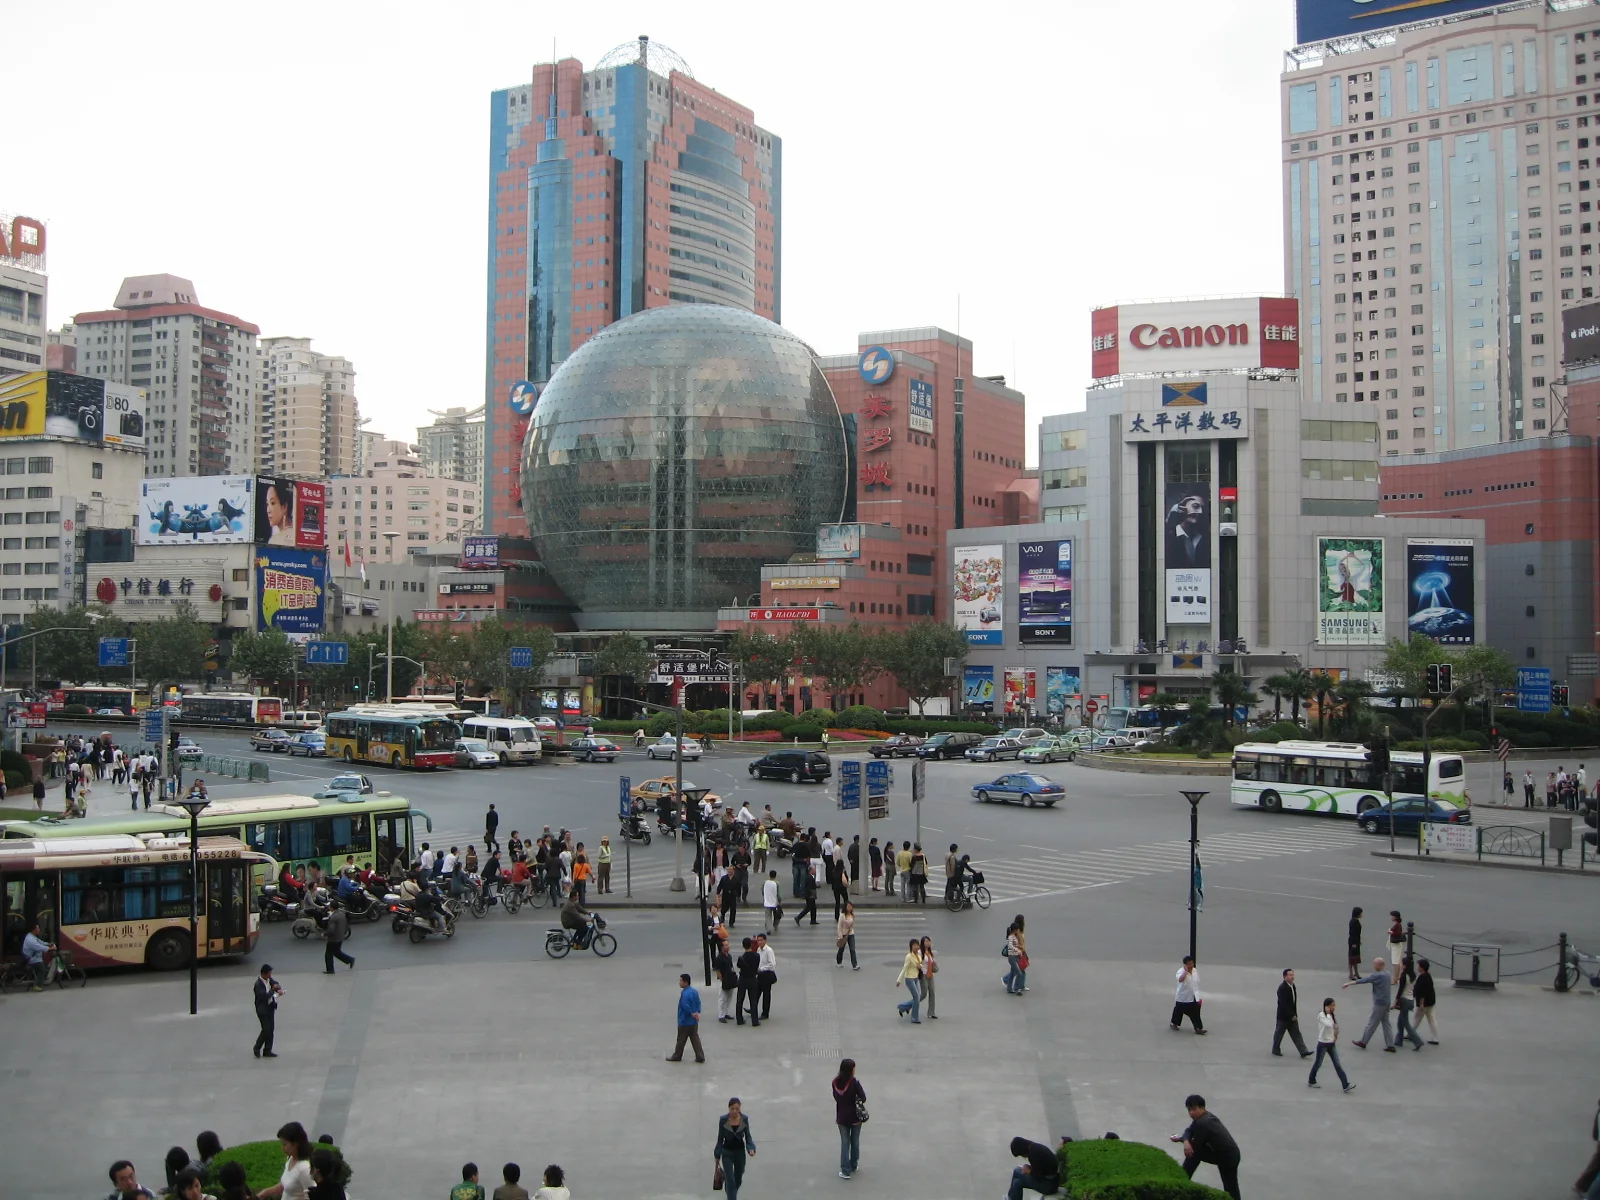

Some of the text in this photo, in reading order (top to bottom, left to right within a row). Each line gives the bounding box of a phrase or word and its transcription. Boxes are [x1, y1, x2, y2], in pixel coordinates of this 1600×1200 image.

[1129, 323, 1248, 350] Canon
[1264, 324, 1297, 342] 佳能
[1092, 333, 1116, 352] 佳能
[106, 395, 129, 411] D80
[911, 405, 931, 418] PHYSICAL
[1129, 411, 1242, 434] 太平洋数码
[859, 394, 894, 486] 美罗城
[465, 545, 494, 557] 伊藤家
[1022, 545, 1043, 553] VAIO
[1321, 618, 1368, 627] SAMSUNG
[660, 663, 697, 673] 舒适堡
[113, 854, 150, 864] 华联典当
[90, 923, 149, 941] 华联典当
